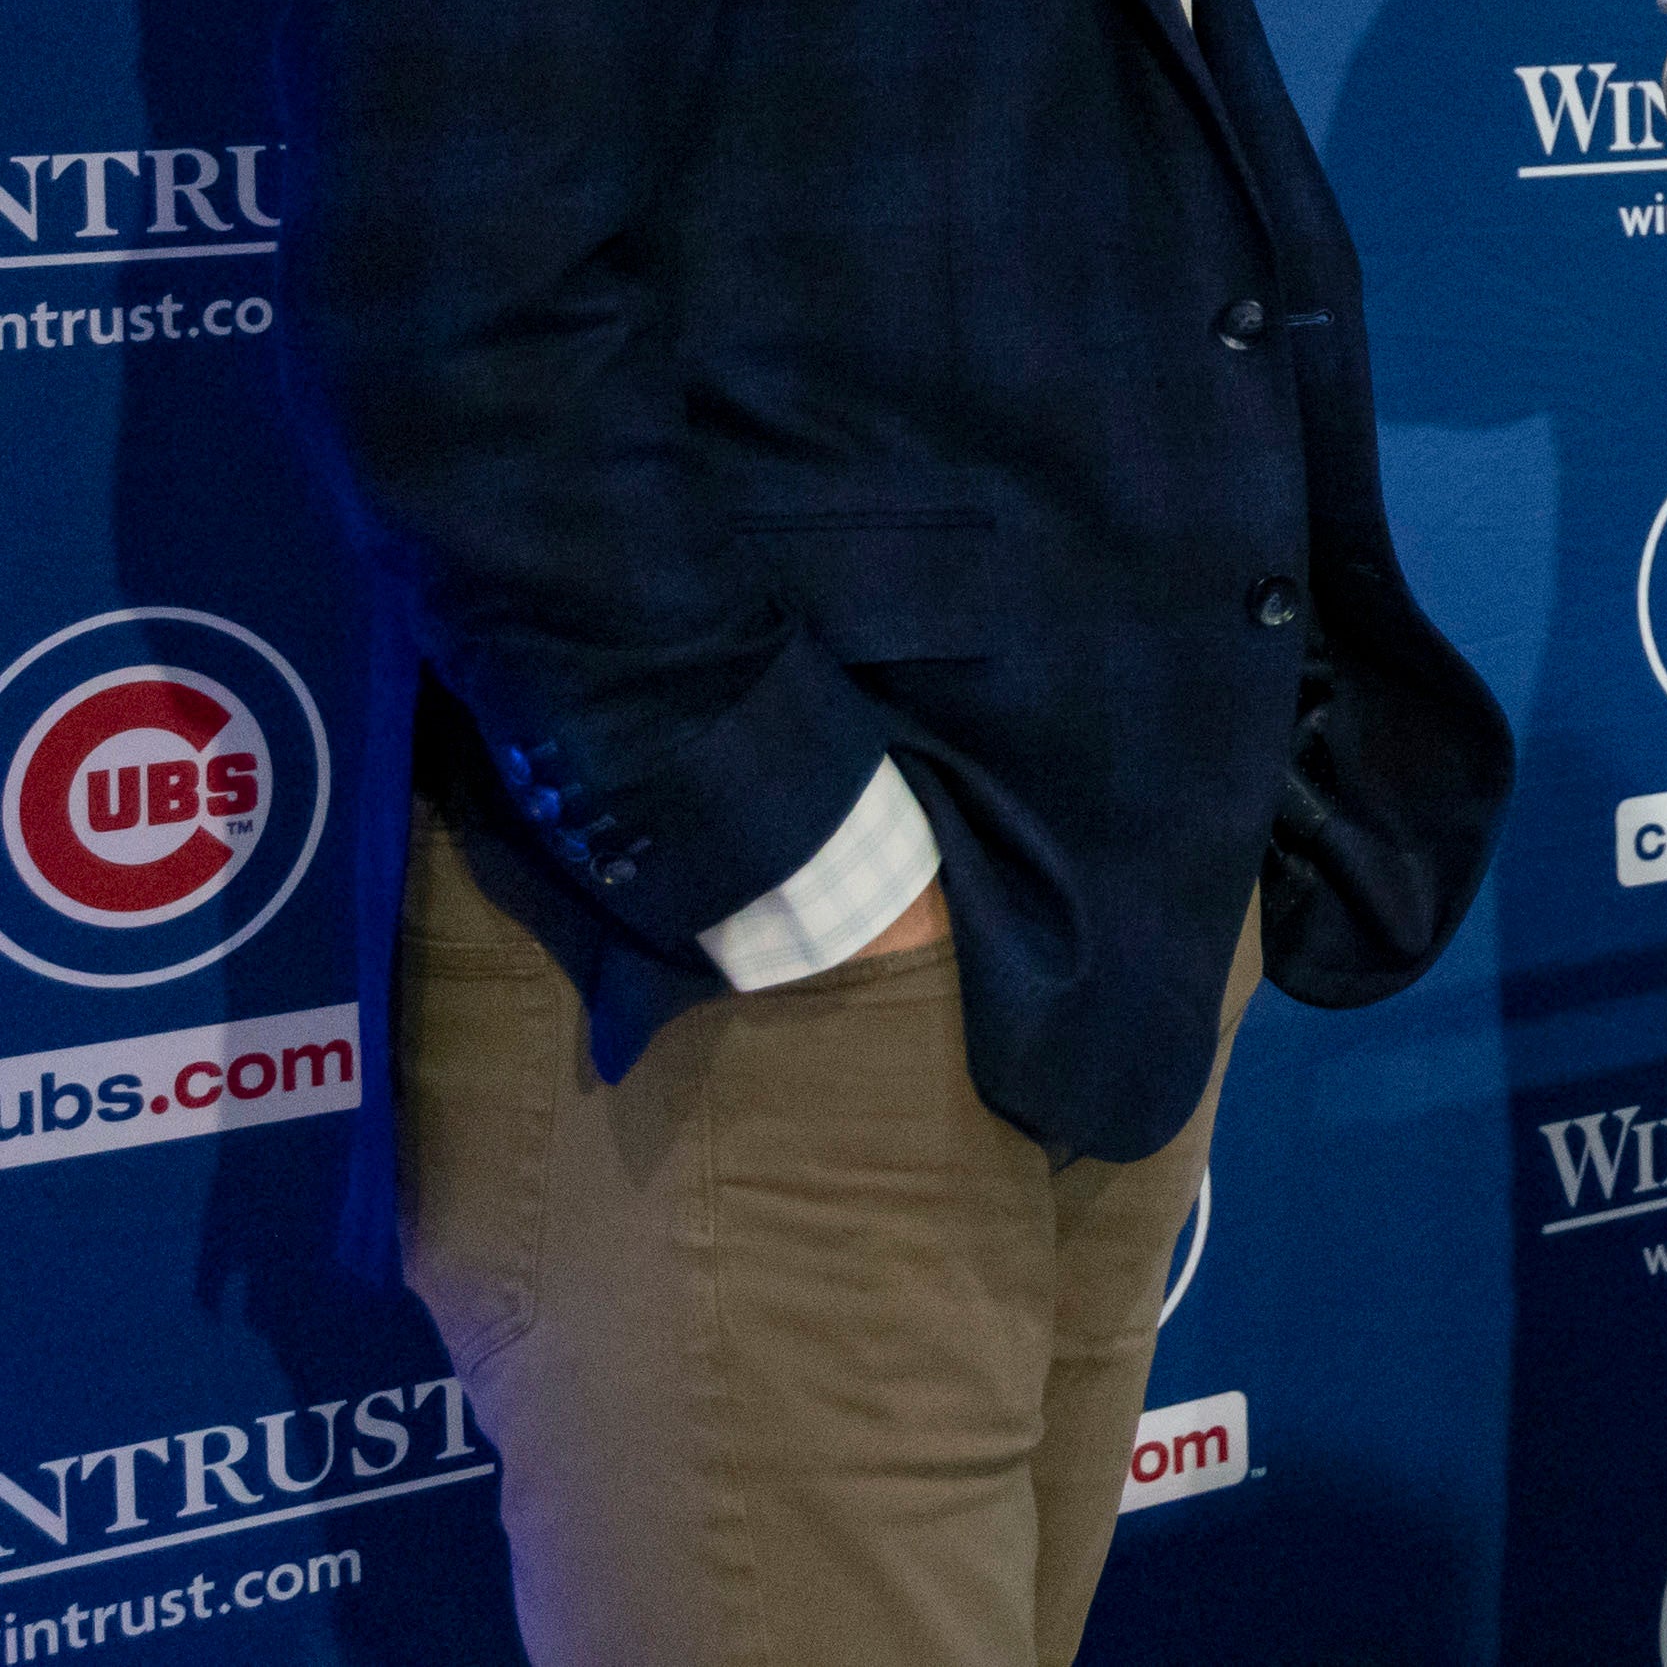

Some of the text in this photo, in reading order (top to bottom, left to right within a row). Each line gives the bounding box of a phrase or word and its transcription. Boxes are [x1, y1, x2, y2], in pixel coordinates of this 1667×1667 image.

[0, 294, 273, 350] ntrust.co
[19, 680, 258, 913] CUBS
[0, 1037, 353, 1141] ubs.com
[0, 1377, 475, 1556] NTRUST
[2, 1548, 361, 1665] intrust.com
